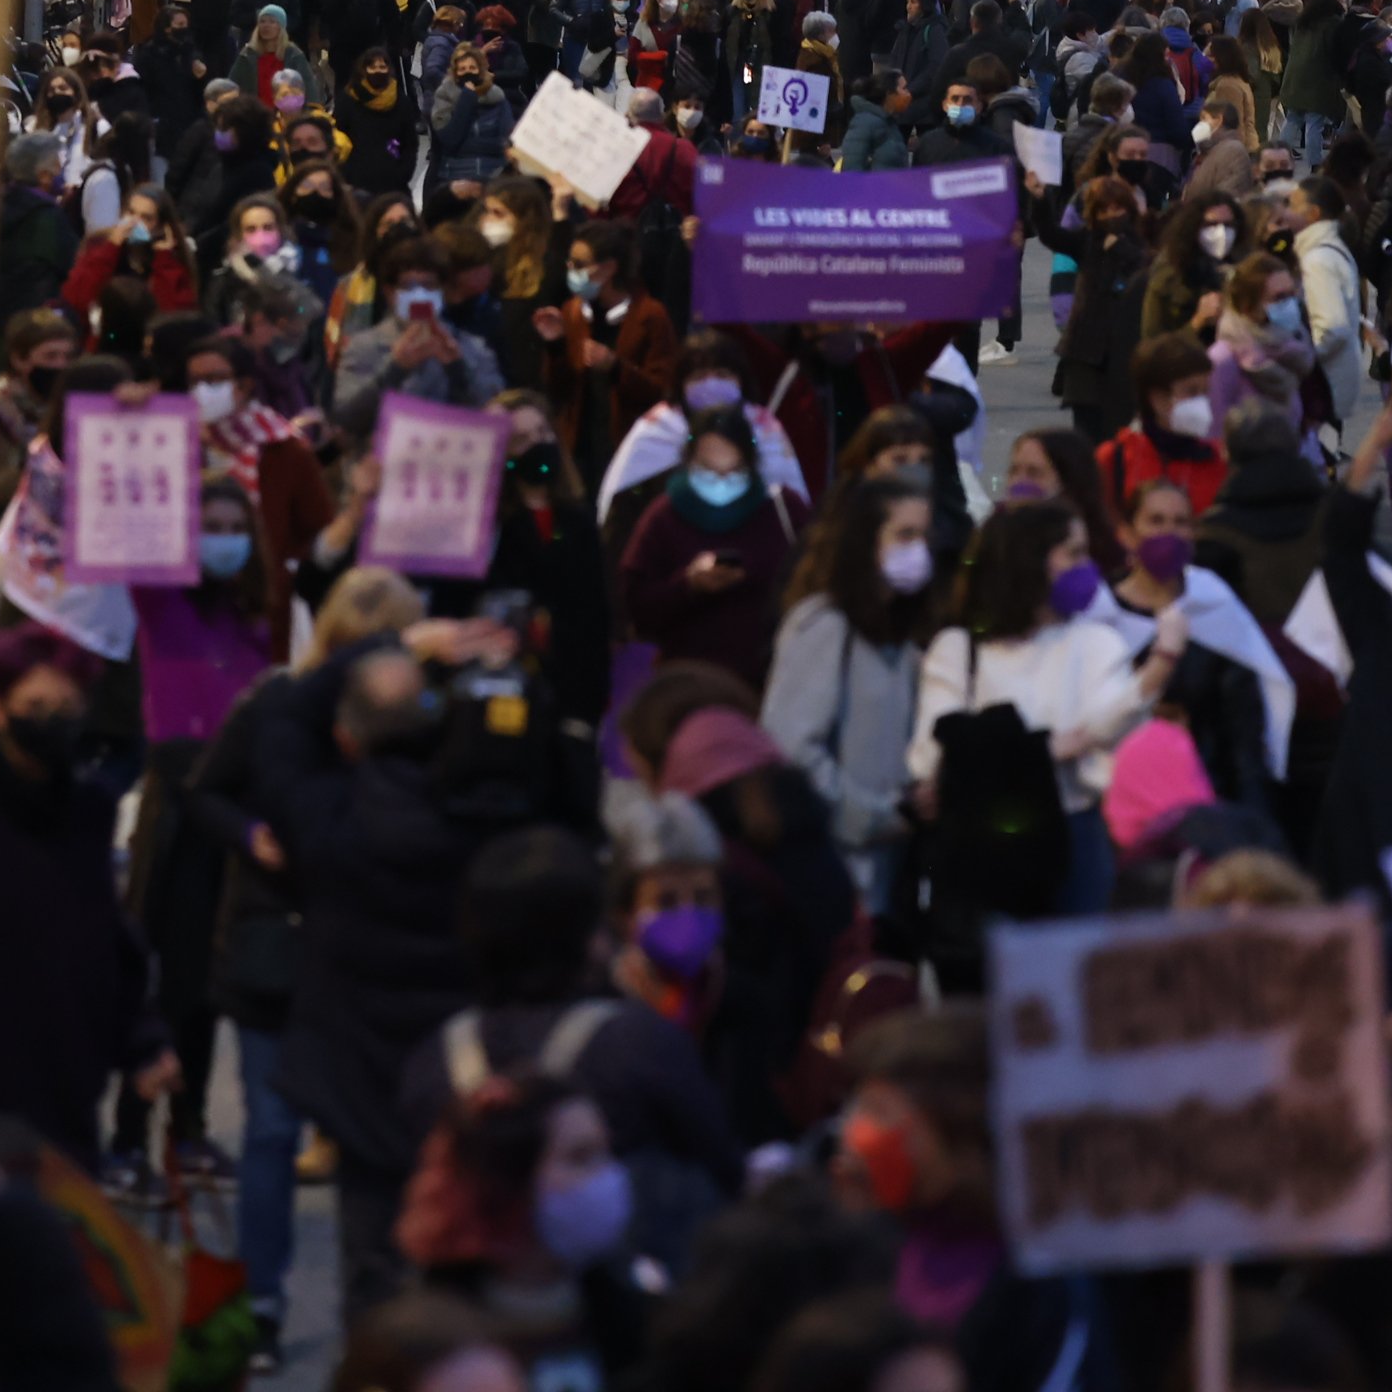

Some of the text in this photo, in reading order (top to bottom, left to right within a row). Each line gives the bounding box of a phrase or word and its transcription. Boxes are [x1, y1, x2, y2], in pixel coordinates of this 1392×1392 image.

[752, 206, 951, 228] LES VIDES AL CENTRE
[819, 253, 887, 275] Catalana
[890, 253, 965, 275] Feminista
